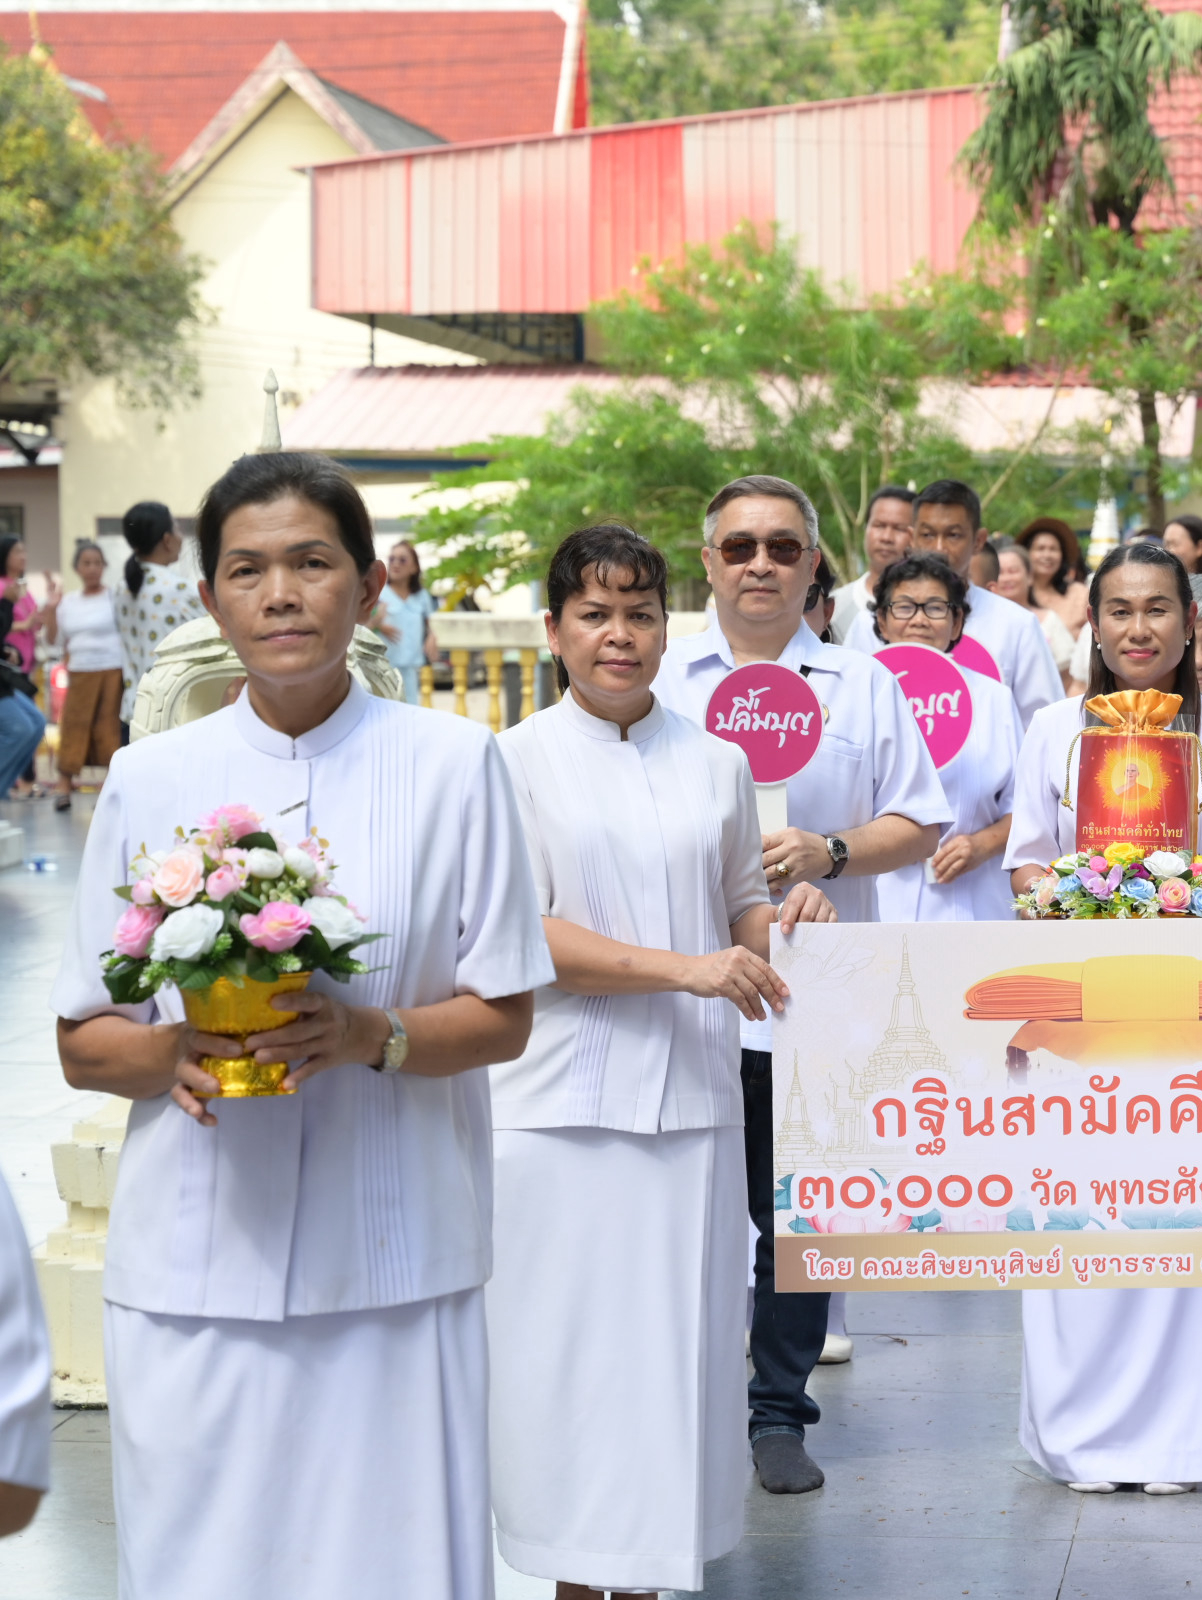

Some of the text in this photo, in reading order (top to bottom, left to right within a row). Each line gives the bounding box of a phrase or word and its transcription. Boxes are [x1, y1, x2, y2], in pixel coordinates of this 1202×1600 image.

[715, 686, 814, 748] ปลื้มบุญ
[1082, 821, 1183, 838] กฐินสามัคคีทั่วไทย
[798, 1174, 1013, 1217] ๓๐,๐๐๐
[1030, 1167, 1076, 1206] วัด
[805, 1252, 850, 1277] โดย
[863, 1247, 1061, 1283] คณะศิษยานุศิษย์
[1072, 1254, 1191, 1283] บูชาธรรม
